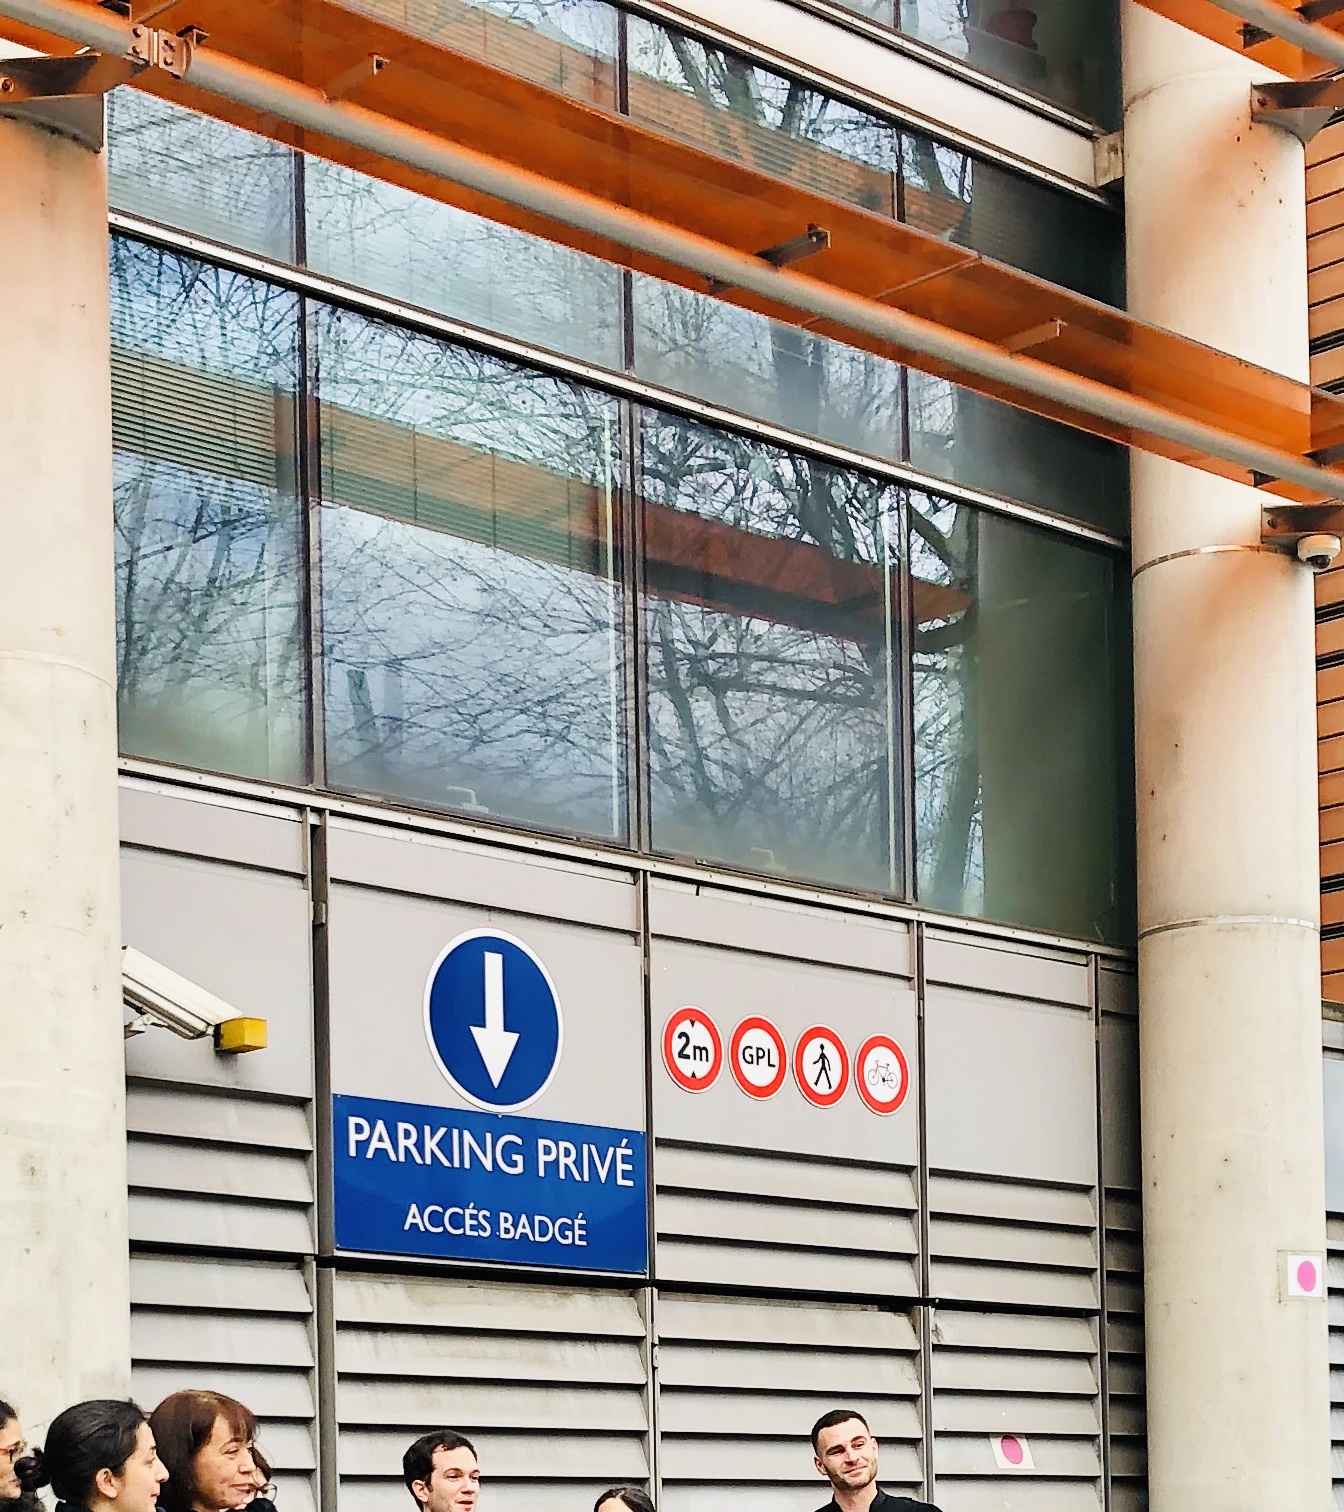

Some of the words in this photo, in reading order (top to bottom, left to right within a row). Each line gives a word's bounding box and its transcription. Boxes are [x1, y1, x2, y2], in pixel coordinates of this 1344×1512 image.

[677, 1031, 710, 1063] 2m
[742, 1044, 776, 1069] GPL
[347, 1116, 524, 1175] PARKING
[537, 1139, 635, 1188] PRIVÉ
[499, 1209, 588, 1246] BADGÉ
